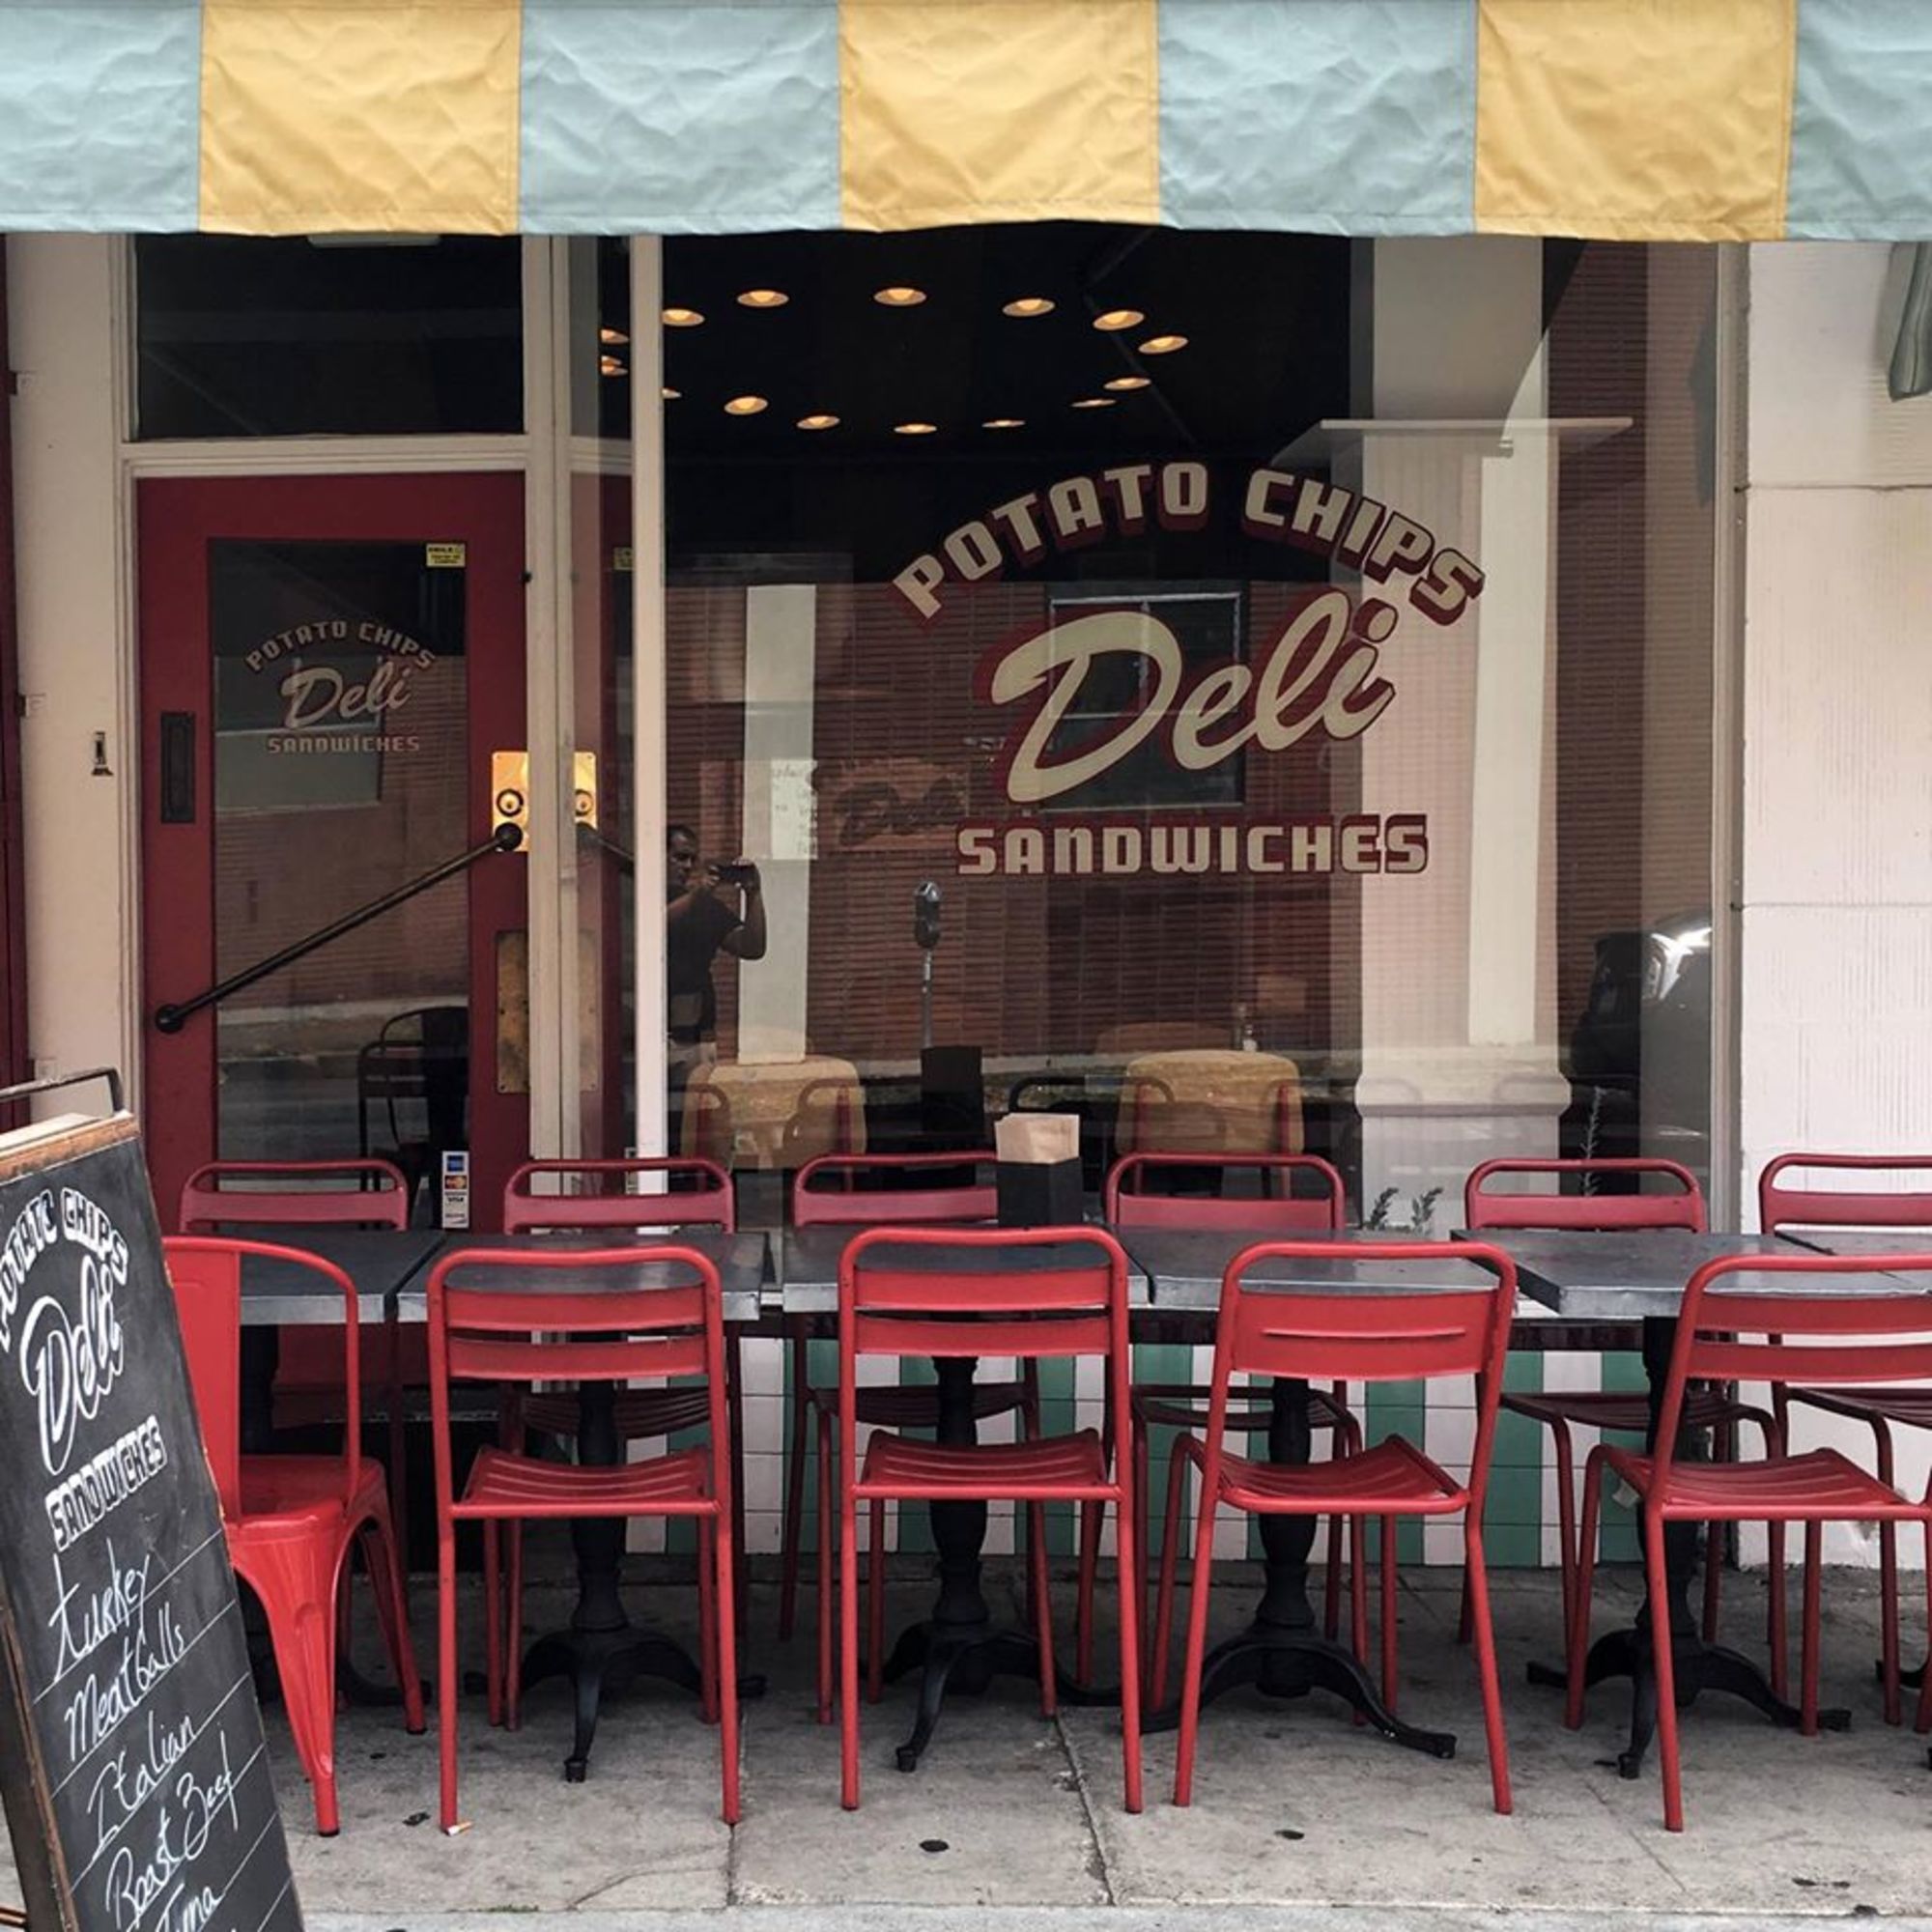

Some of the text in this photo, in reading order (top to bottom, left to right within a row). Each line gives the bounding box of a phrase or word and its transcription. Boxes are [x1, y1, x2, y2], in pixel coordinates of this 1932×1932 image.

[893, 462, 1486, 626] POTATO CHIPS
[245, 620, 436, 672] POTATO CHIPS
[280, 660, 412, 728] Deli
[980, 587, 1397, 802] Deli
[267, 736, 421, 753] SANDWICHES
[955, 814, 1428, 874] SANDWICHES
[61, 1187, 129, 1287] CHIPS
[19, 1255, 124, 1476] Deli
[45, 1414, 168, 1552] SANDWICHES
[87, 1710, 197, 1861] Italian
